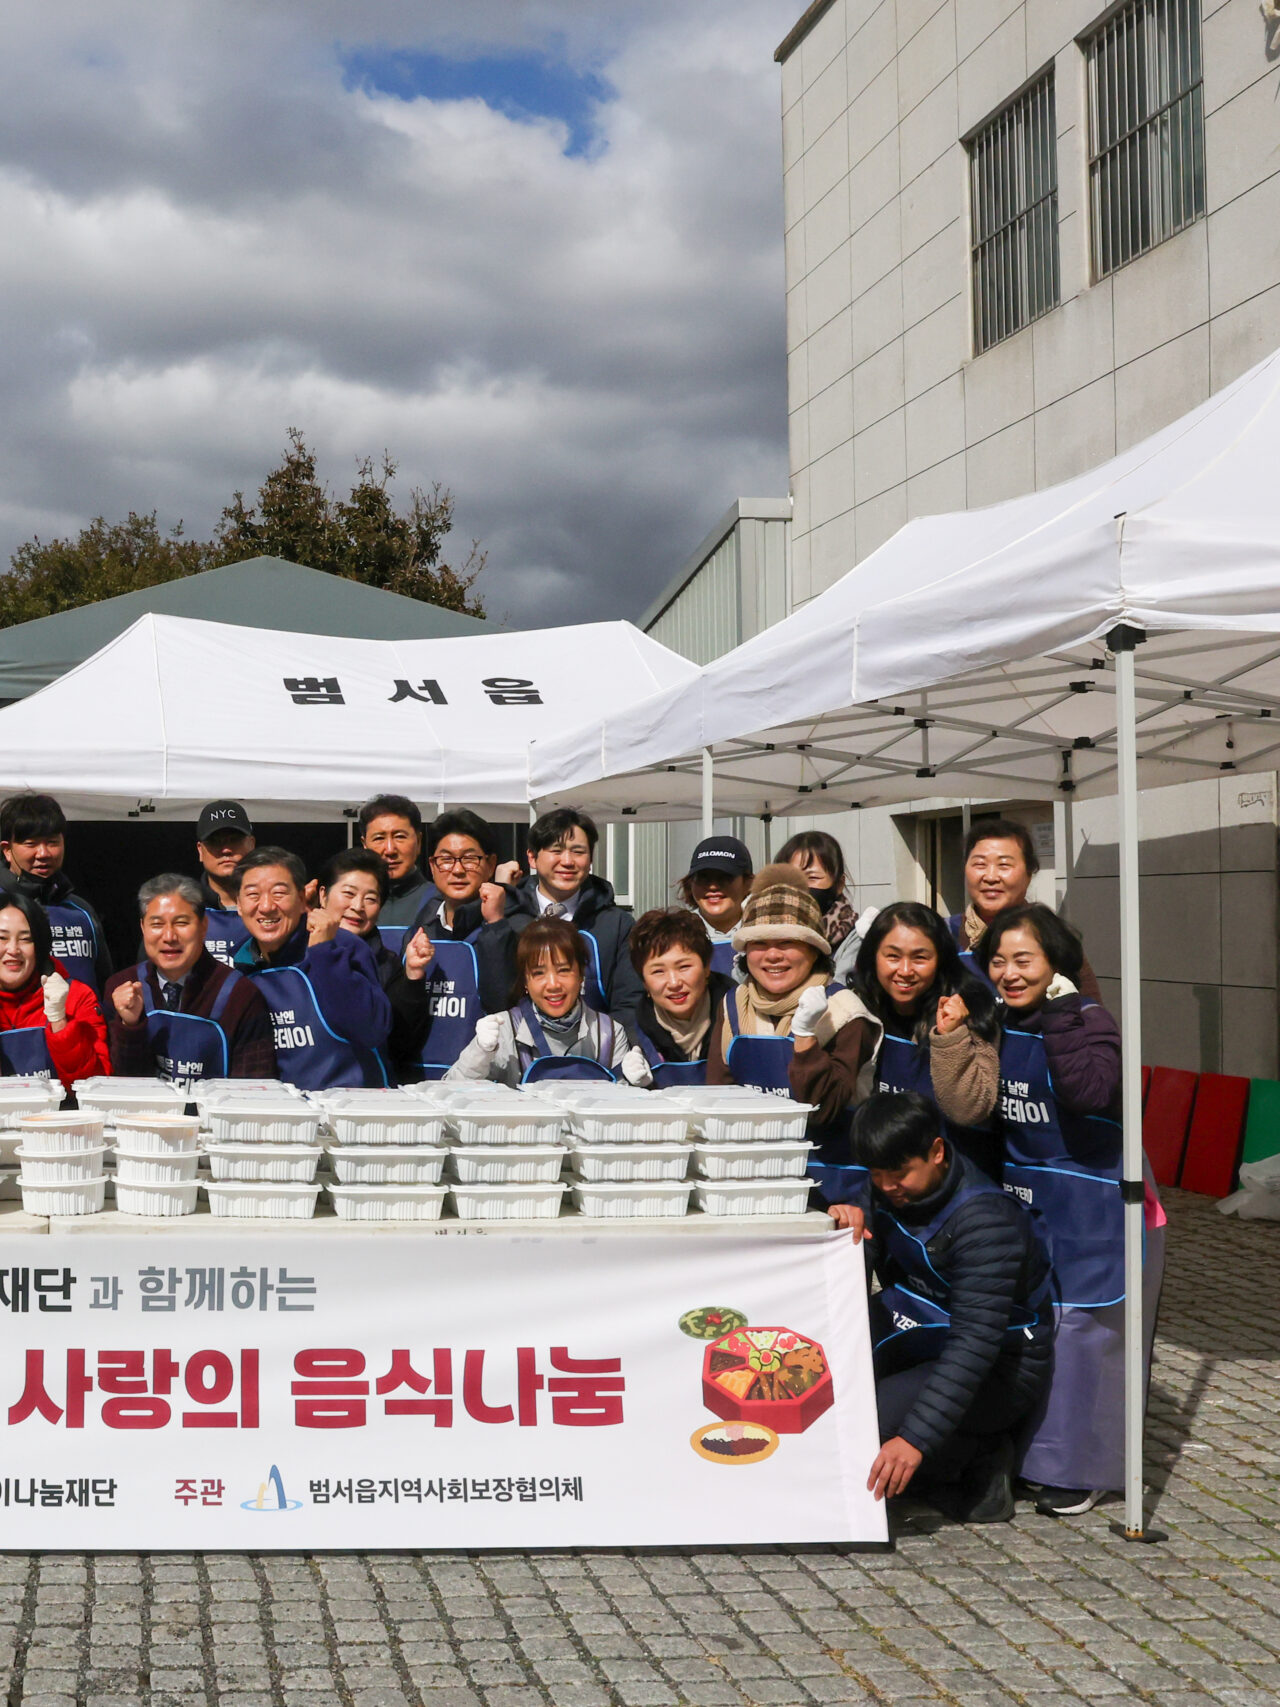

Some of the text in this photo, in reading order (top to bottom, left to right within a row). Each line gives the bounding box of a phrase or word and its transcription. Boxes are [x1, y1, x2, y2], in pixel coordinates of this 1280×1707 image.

[210, 809, 236, 821] NYC
[697, 850, 736, 859] SALOMON
[65, 926, 83, 938] 날엔
[50, 940, 93, 958] 은데이
[429, 996, 466, 1018] 데이
[275, 1010, 296, 1025] 날엔
[274, 1025, 315, 1050] 데이
[177, 1060, 204, 1075] 날엔
[1008, 1080, 1029, 1098] 날엔
[1001, 1096, 1050, 1123] 데이
[89, 1276, 123, 1310] 과
[138, 1266, 317, 1312] 함께하는
[8, 1348, 259, 1429] 사랑의
[291, 1346, 625, 1429] 음식나눔
[173, 1476, 584, 1506] 주관 범서읍지역사회보장협의체
